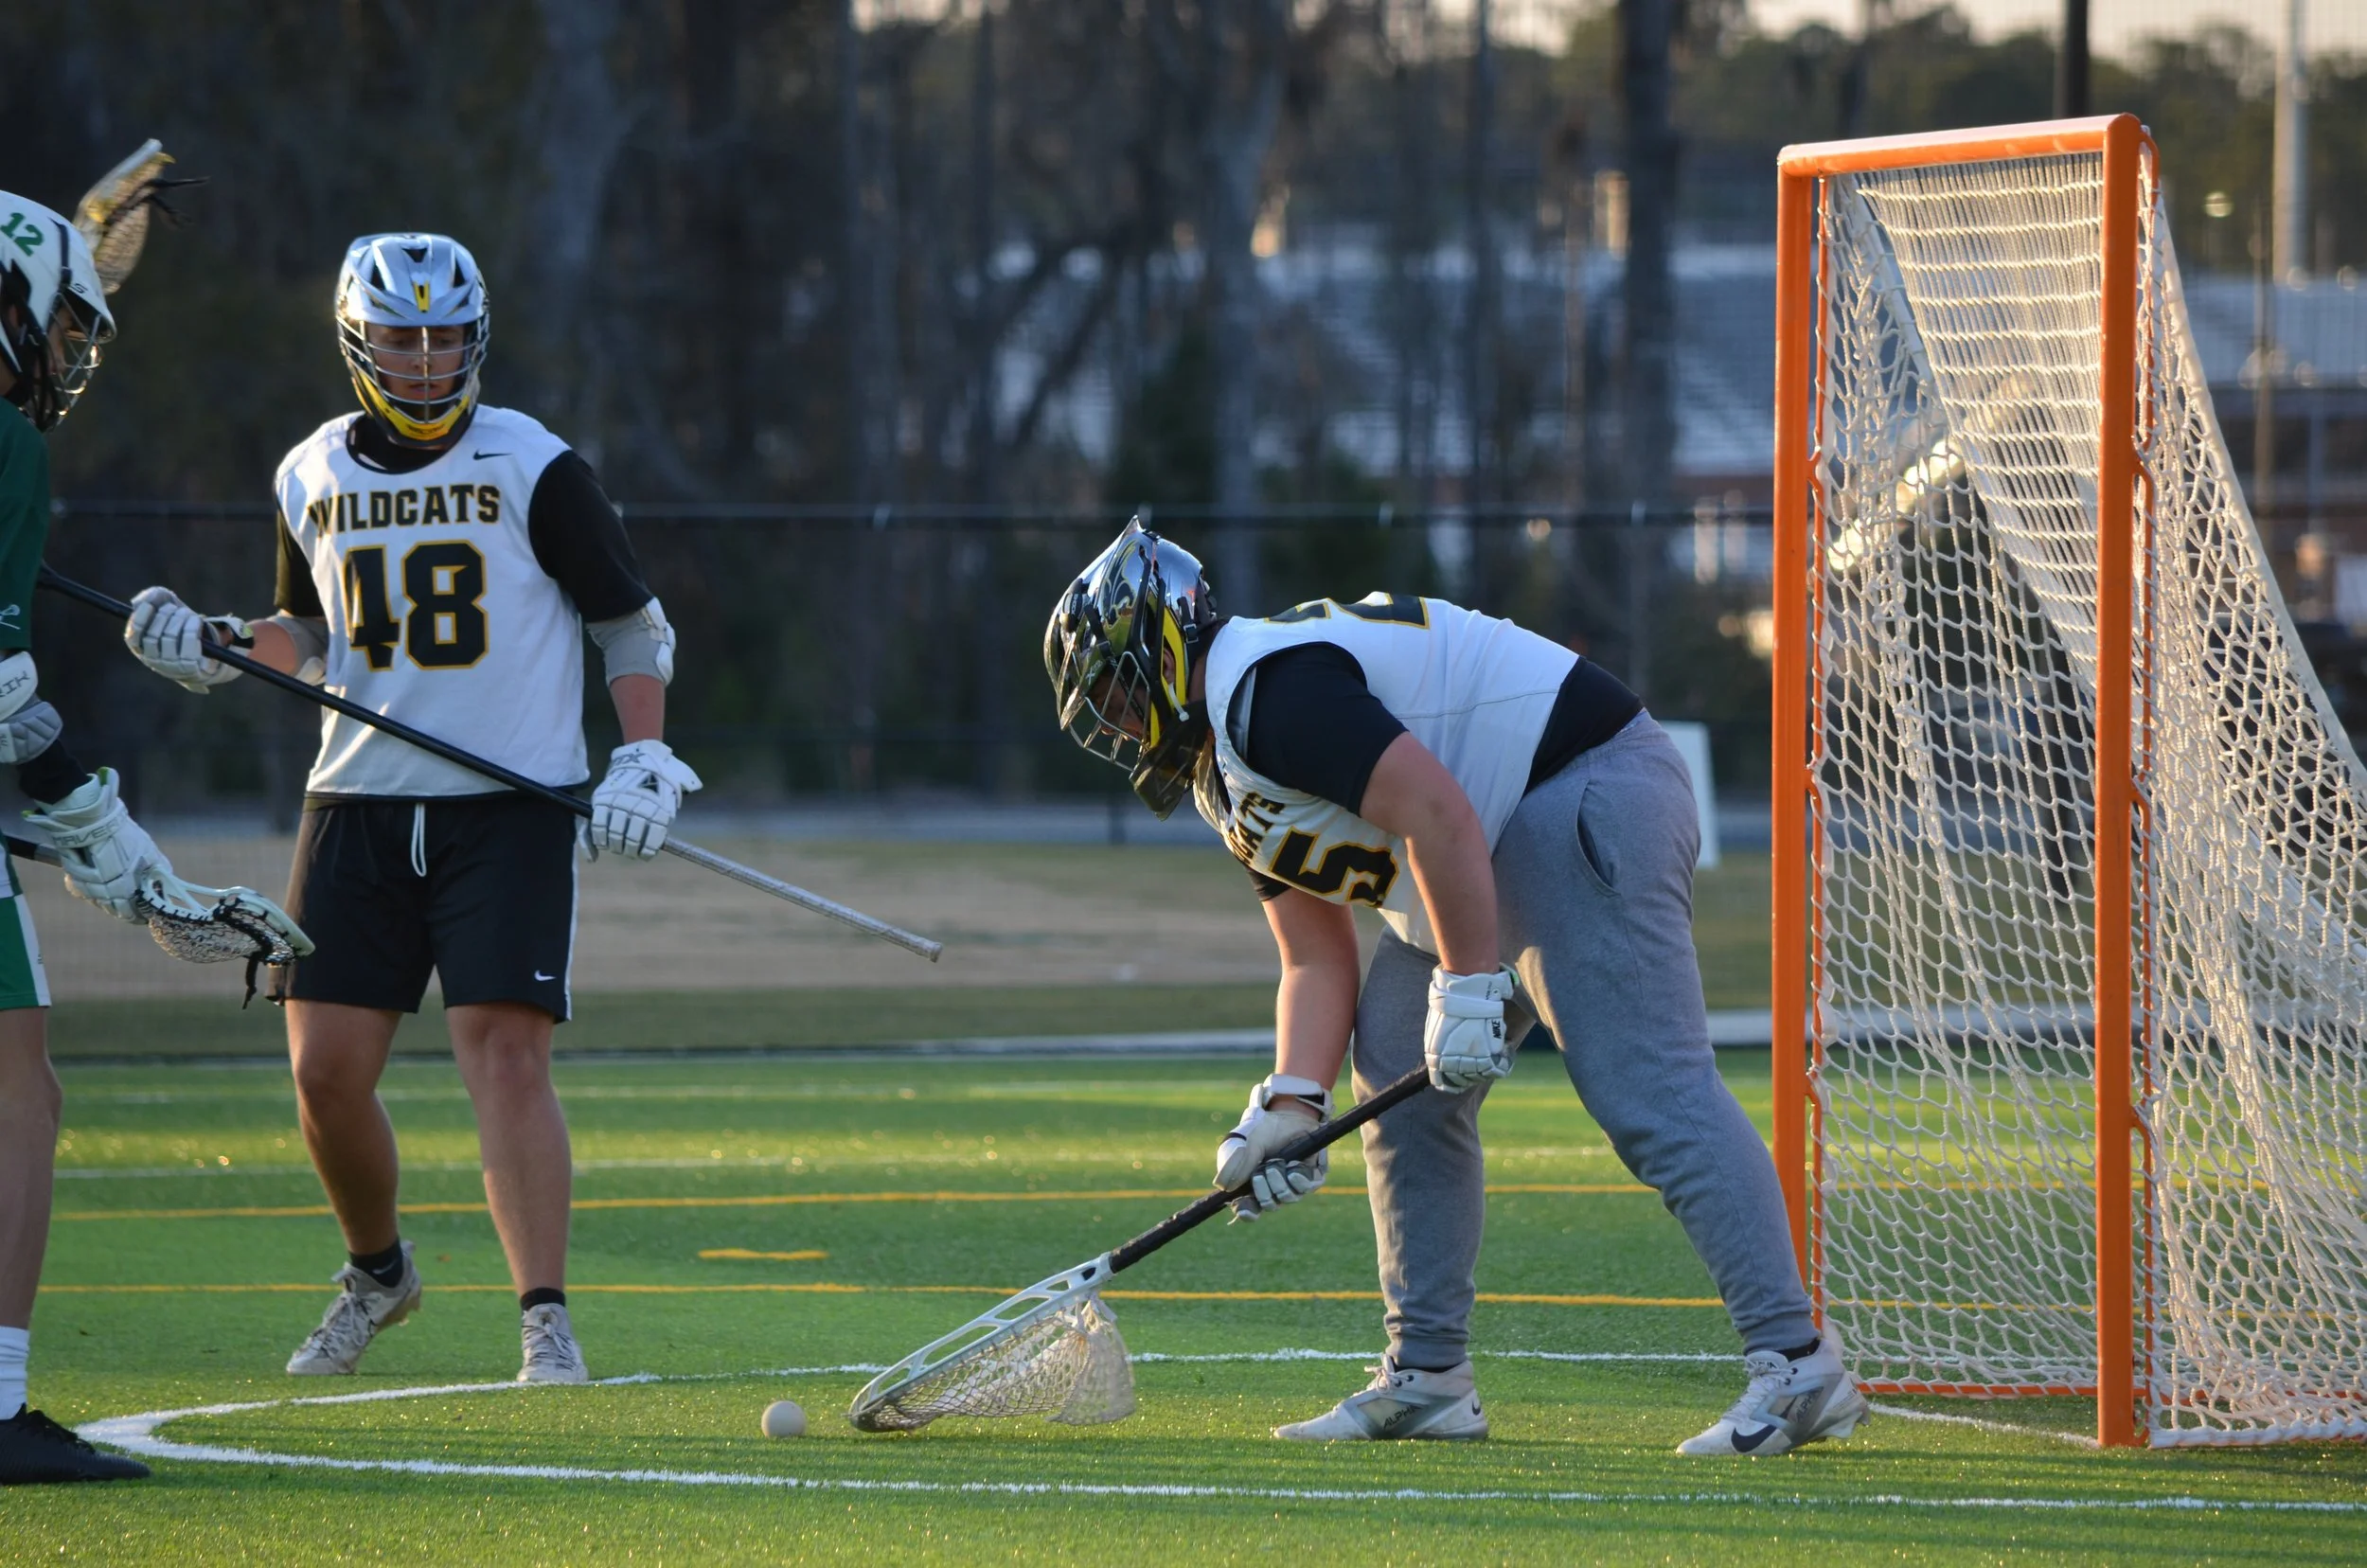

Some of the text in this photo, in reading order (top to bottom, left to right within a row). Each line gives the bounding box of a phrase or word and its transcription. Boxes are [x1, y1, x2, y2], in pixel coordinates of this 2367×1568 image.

[0, 212, 44, 257] 12
[308, 484, 500, 538] WILDCATS
[345, 541, 488, 671] 48
[1228, 792, 1285, 864] CATS
[1491, 1019, 1502, 1039] NIKE
